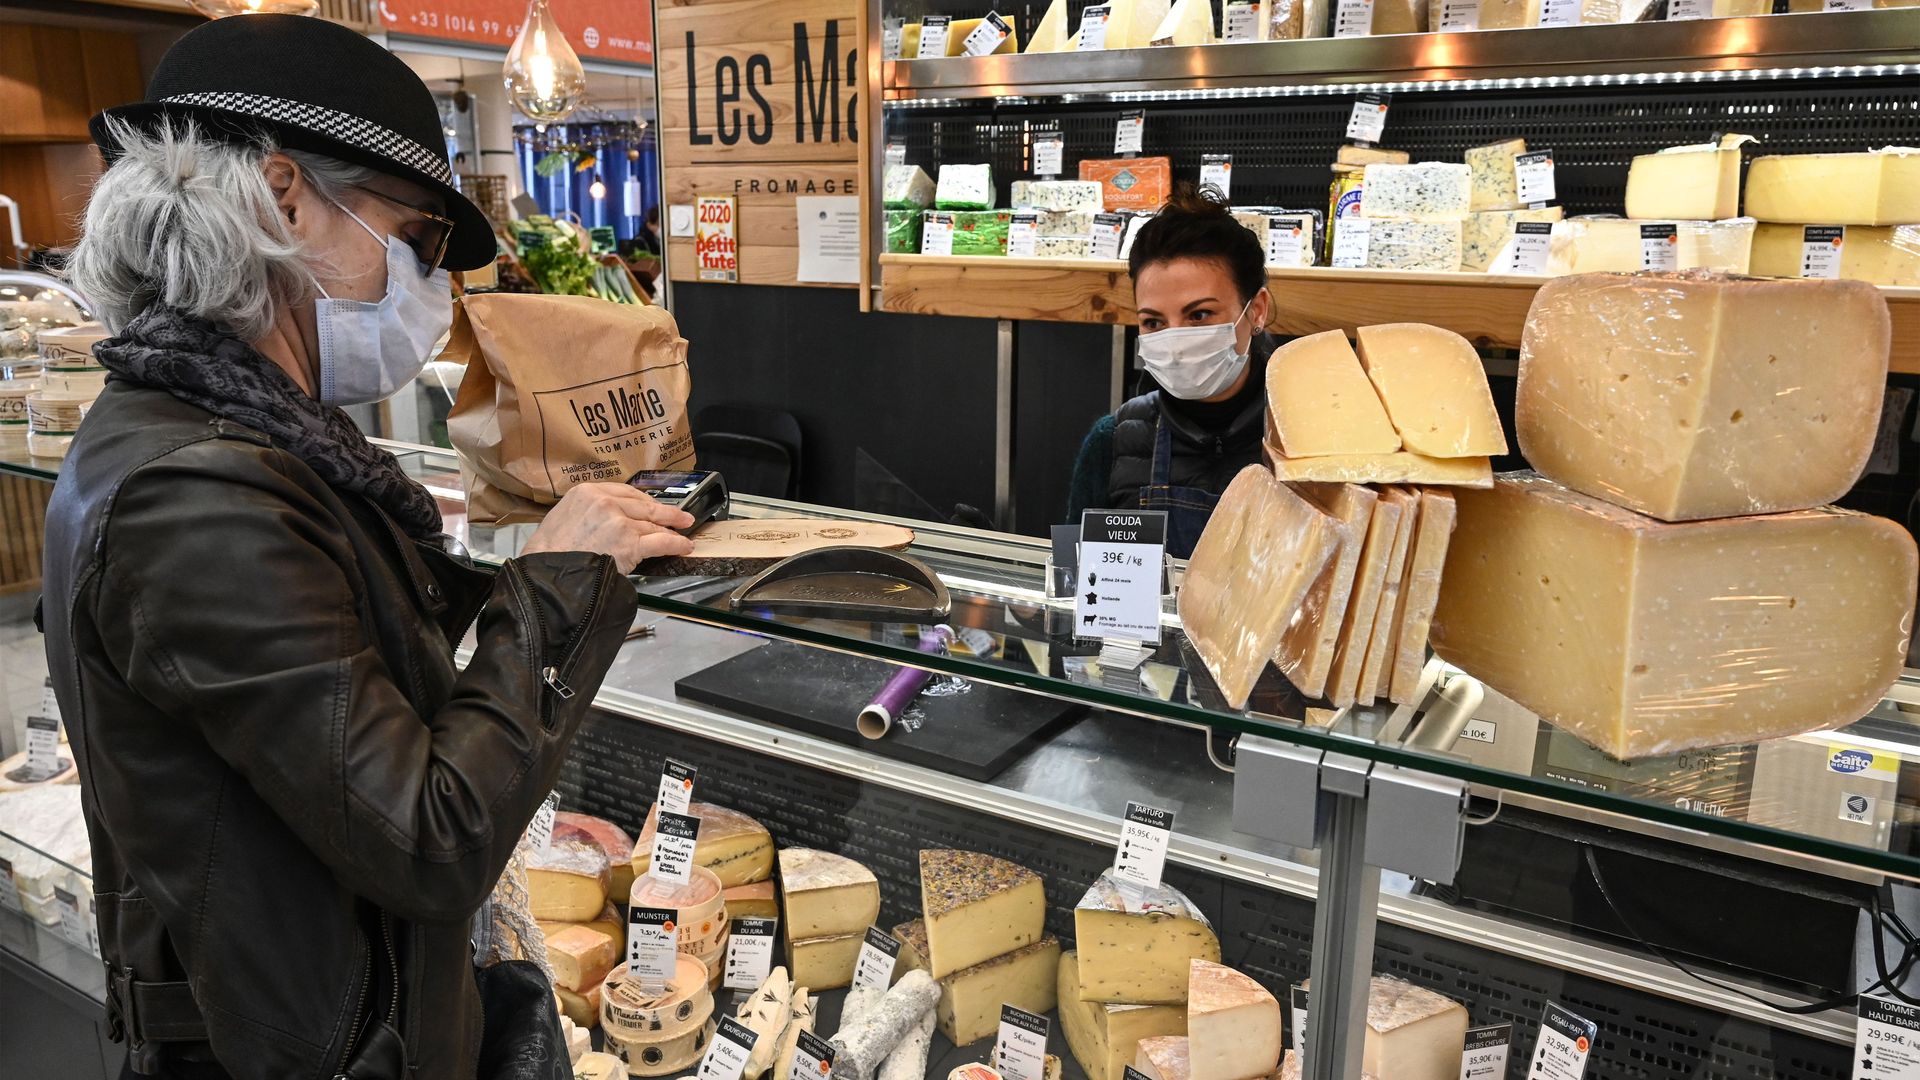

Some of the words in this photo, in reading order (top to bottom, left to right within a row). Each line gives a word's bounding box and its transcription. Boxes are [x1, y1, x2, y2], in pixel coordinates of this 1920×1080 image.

[481, 20, 499, 35] 99
[686, 31, 773, 145] Les
[735, 179, 853, 193] FROMAGE
[700, 204, 731, 223] 2020
[696, 233, 736, 255] petit
[570, 399, 610, 437] Les
[608, 383, 665, 430] Marie
[595, 426, 673, 454] FROMAGERIE
[561, 463, 587, 474] Halles
[570, 473, 580, 483] 04
[582, 472, 591, 481] 67
[593, 470, 604, 480] 60
[1105, 515, 1142, 526] GOUDA
[1108, 531, 1137, 541] VIEUX
[1102, 552, 1124, 563] 39€
[1133, 556, 1142, 566] kg
[1471, 730, 1487, 739] 10€
[1831, 753, 1871, 768] Caïto
[1135, 805, 1164, 819] TARTUFO
[1127, 827, 1150, 839] 35,95€
[636, 912, 670, 920] MUNSTER
[1879, 1001, 1915, 1017] TOMME
[1868, 1010, 1894, 1023] HAUT
[1551, 1014, 1584, 1035] OSSAU-IRATY
[1476, 1030, 1497, 1039] TOMME
[1867, 1028, 1905, 1045] 29,99€
[1465, 1041, 1484, 1050] BREBIS
[1485, 1038, 1506, 1047] CHEVRE
[1546, 1036, 1569, 1054] 32,99€
[796, 1055, 812, 1070] 8,50€
[1469, 1054, 1491, 1065] 35,90€
